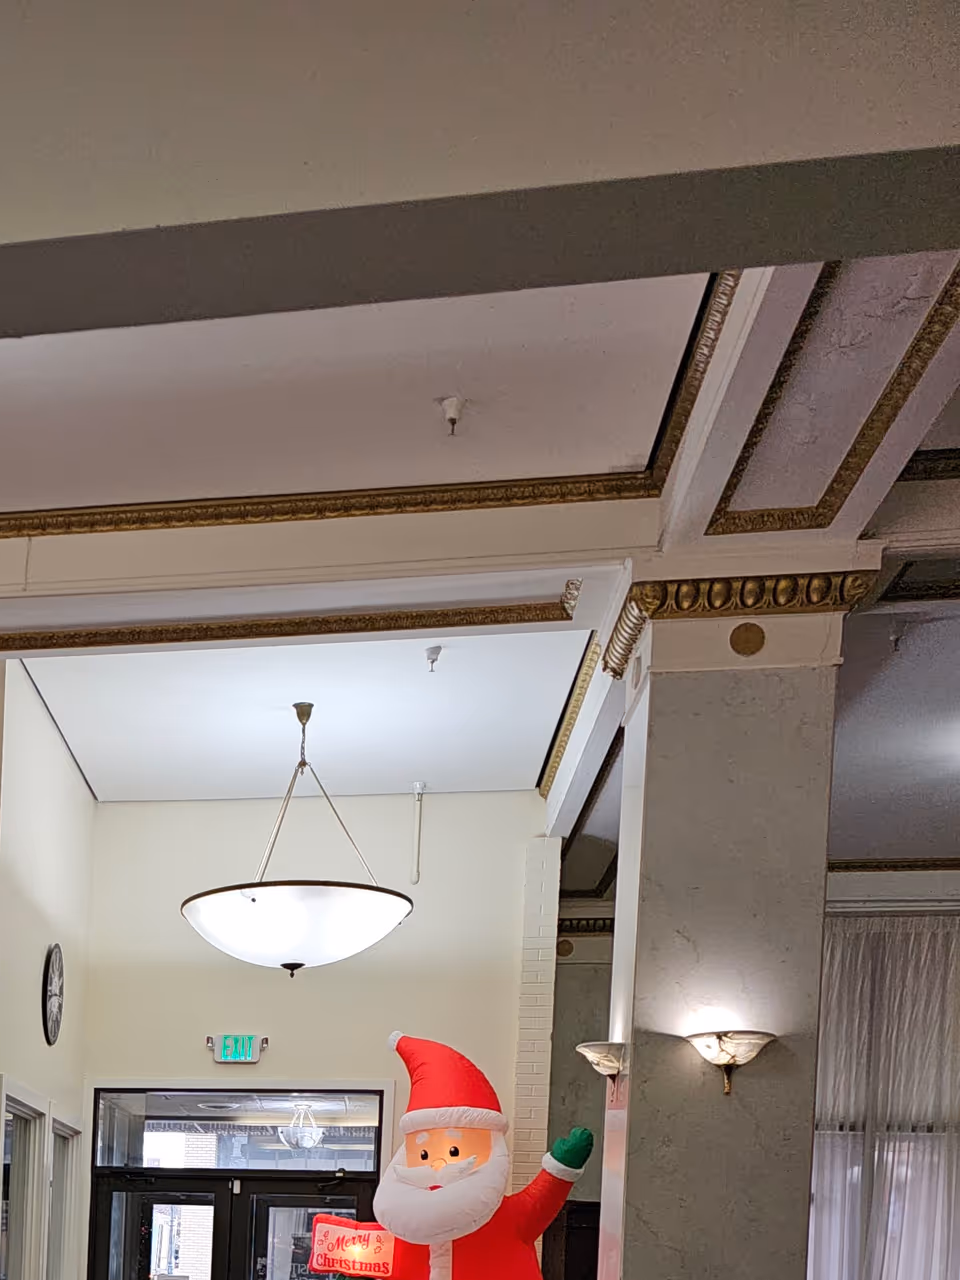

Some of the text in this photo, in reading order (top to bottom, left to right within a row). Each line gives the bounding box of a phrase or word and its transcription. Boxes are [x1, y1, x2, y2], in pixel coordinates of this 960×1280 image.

[221, 1035, 254, 1060] EXIT
[326, 1232, 371, 1252] Merry
[315, 1252, 390, 1275] Christmas
